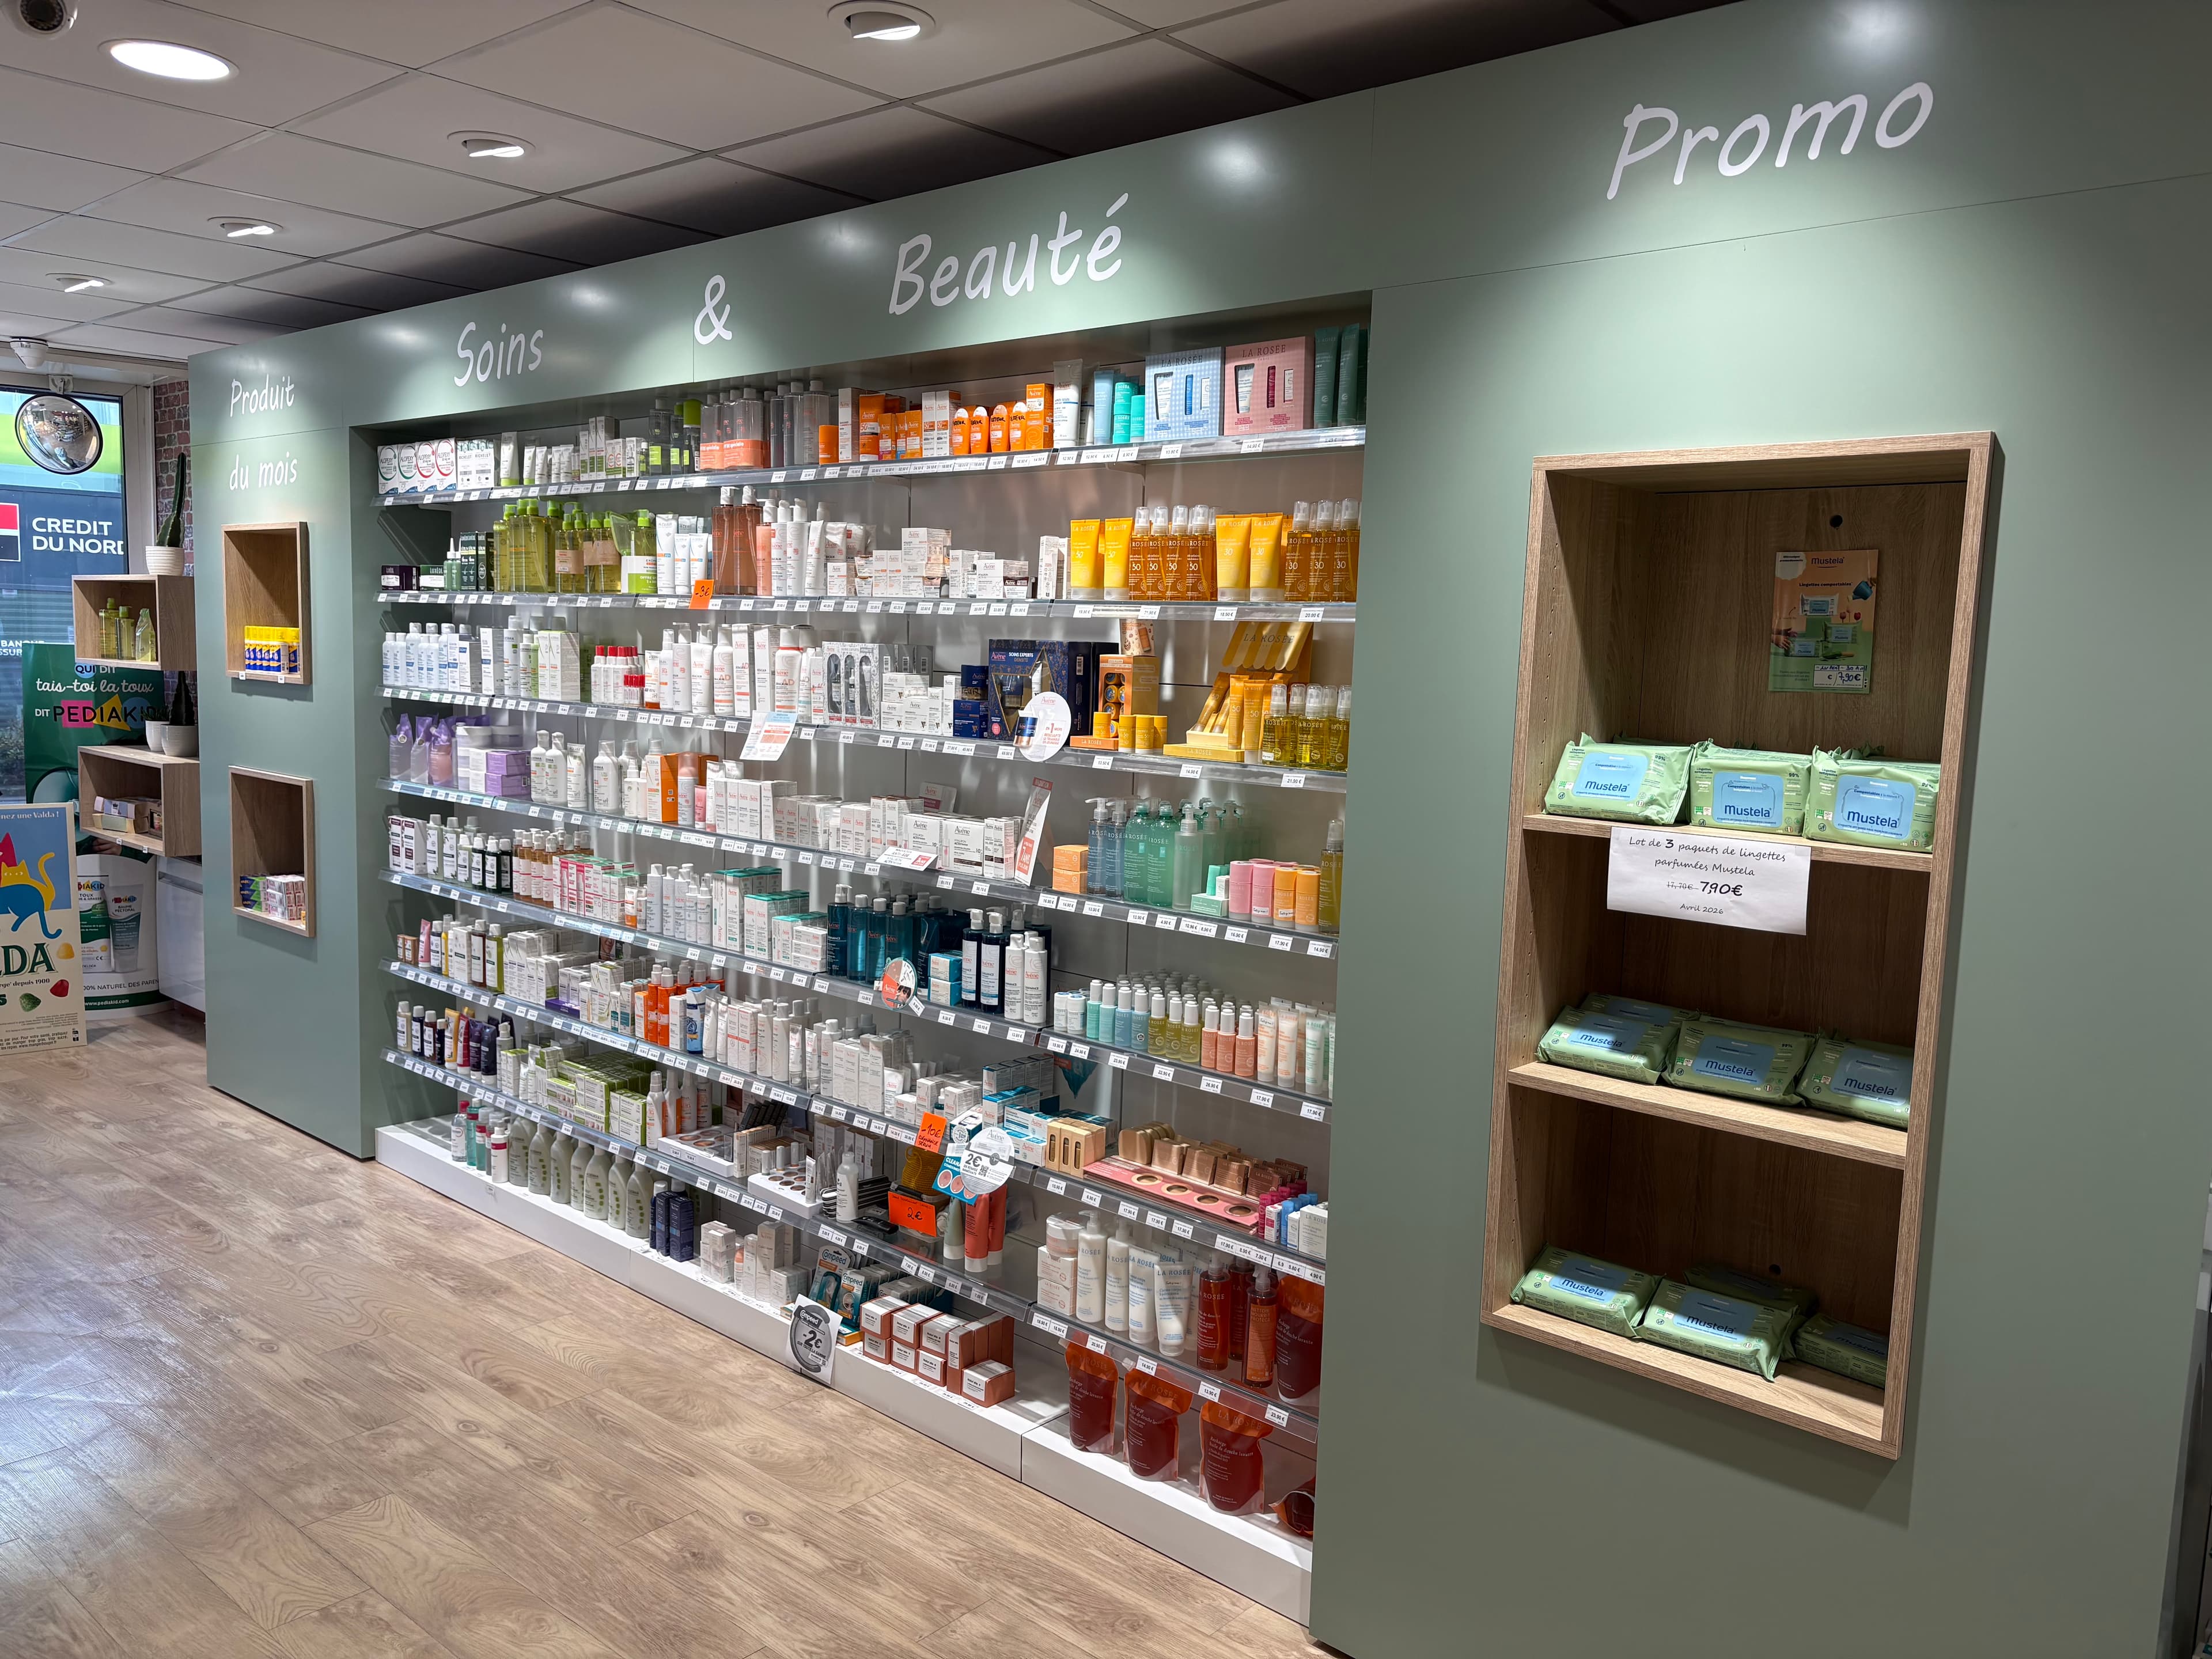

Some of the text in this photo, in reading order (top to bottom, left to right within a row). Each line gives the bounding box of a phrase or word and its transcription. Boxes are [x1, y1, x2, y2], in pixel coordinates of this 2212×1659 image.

[1607, 82, 1933, 200] Promo
[453, 192, 1129, 387] Soins & Beauté
[1243, 348, 1253, 357] LA
[1176, 355, 1203, 366] ROSÉE
[230, 374, 294, 417] Produit
[229, 452, 298, 490] du mois
[32, 517, 112, 536] CREDIT
[33, 536, 63, 551] DU
[1243, 633, 1256, 641] LA
[991, 652, 1006, 660] Avène
[75, 665, 95, 674] QUI
[36, 678, 154, 693] tais-toi la toux
[1585, 781, 1628, 792] Mustela
[1725, 805, 1770, 817] Mustela
[913, 820, 927, 828] Avène
[1847, 810, 1897, 828] Mustela
[954, 825, 971, 835] Avène
[1629, 836, 1786, 862] Lot de 3 paquets de lingettes
[1655, 858, 1755, 876] parfumées Mustela
[1700, 881, 1743, 897] 7,90€
[1680, 903, 1724, 915] Avril 2026
[0, 942, 58, 977] DA
[1580, 1033, 1623, 1048] Mustela
[1705, 1059, 1754, 1077] Mustela
[1843, 1076, 1896, 1096] Mustela
[922, 1124, 941, 1138] -10€
[965, 1153, 982, 1167] 2€
[823, 1249, 846, 1264] Compeed
[842, 1273, 863, 1286] Compeed
[1561, 1278, 1604, 1298] Mustela
[800, 1310, 819, 1325] Compeed
[1685, 1313, 1734, 1335] Mustela
[803, 1330, 823, 1349] -2€
[1217, 1410, 1229, 1421] LA
